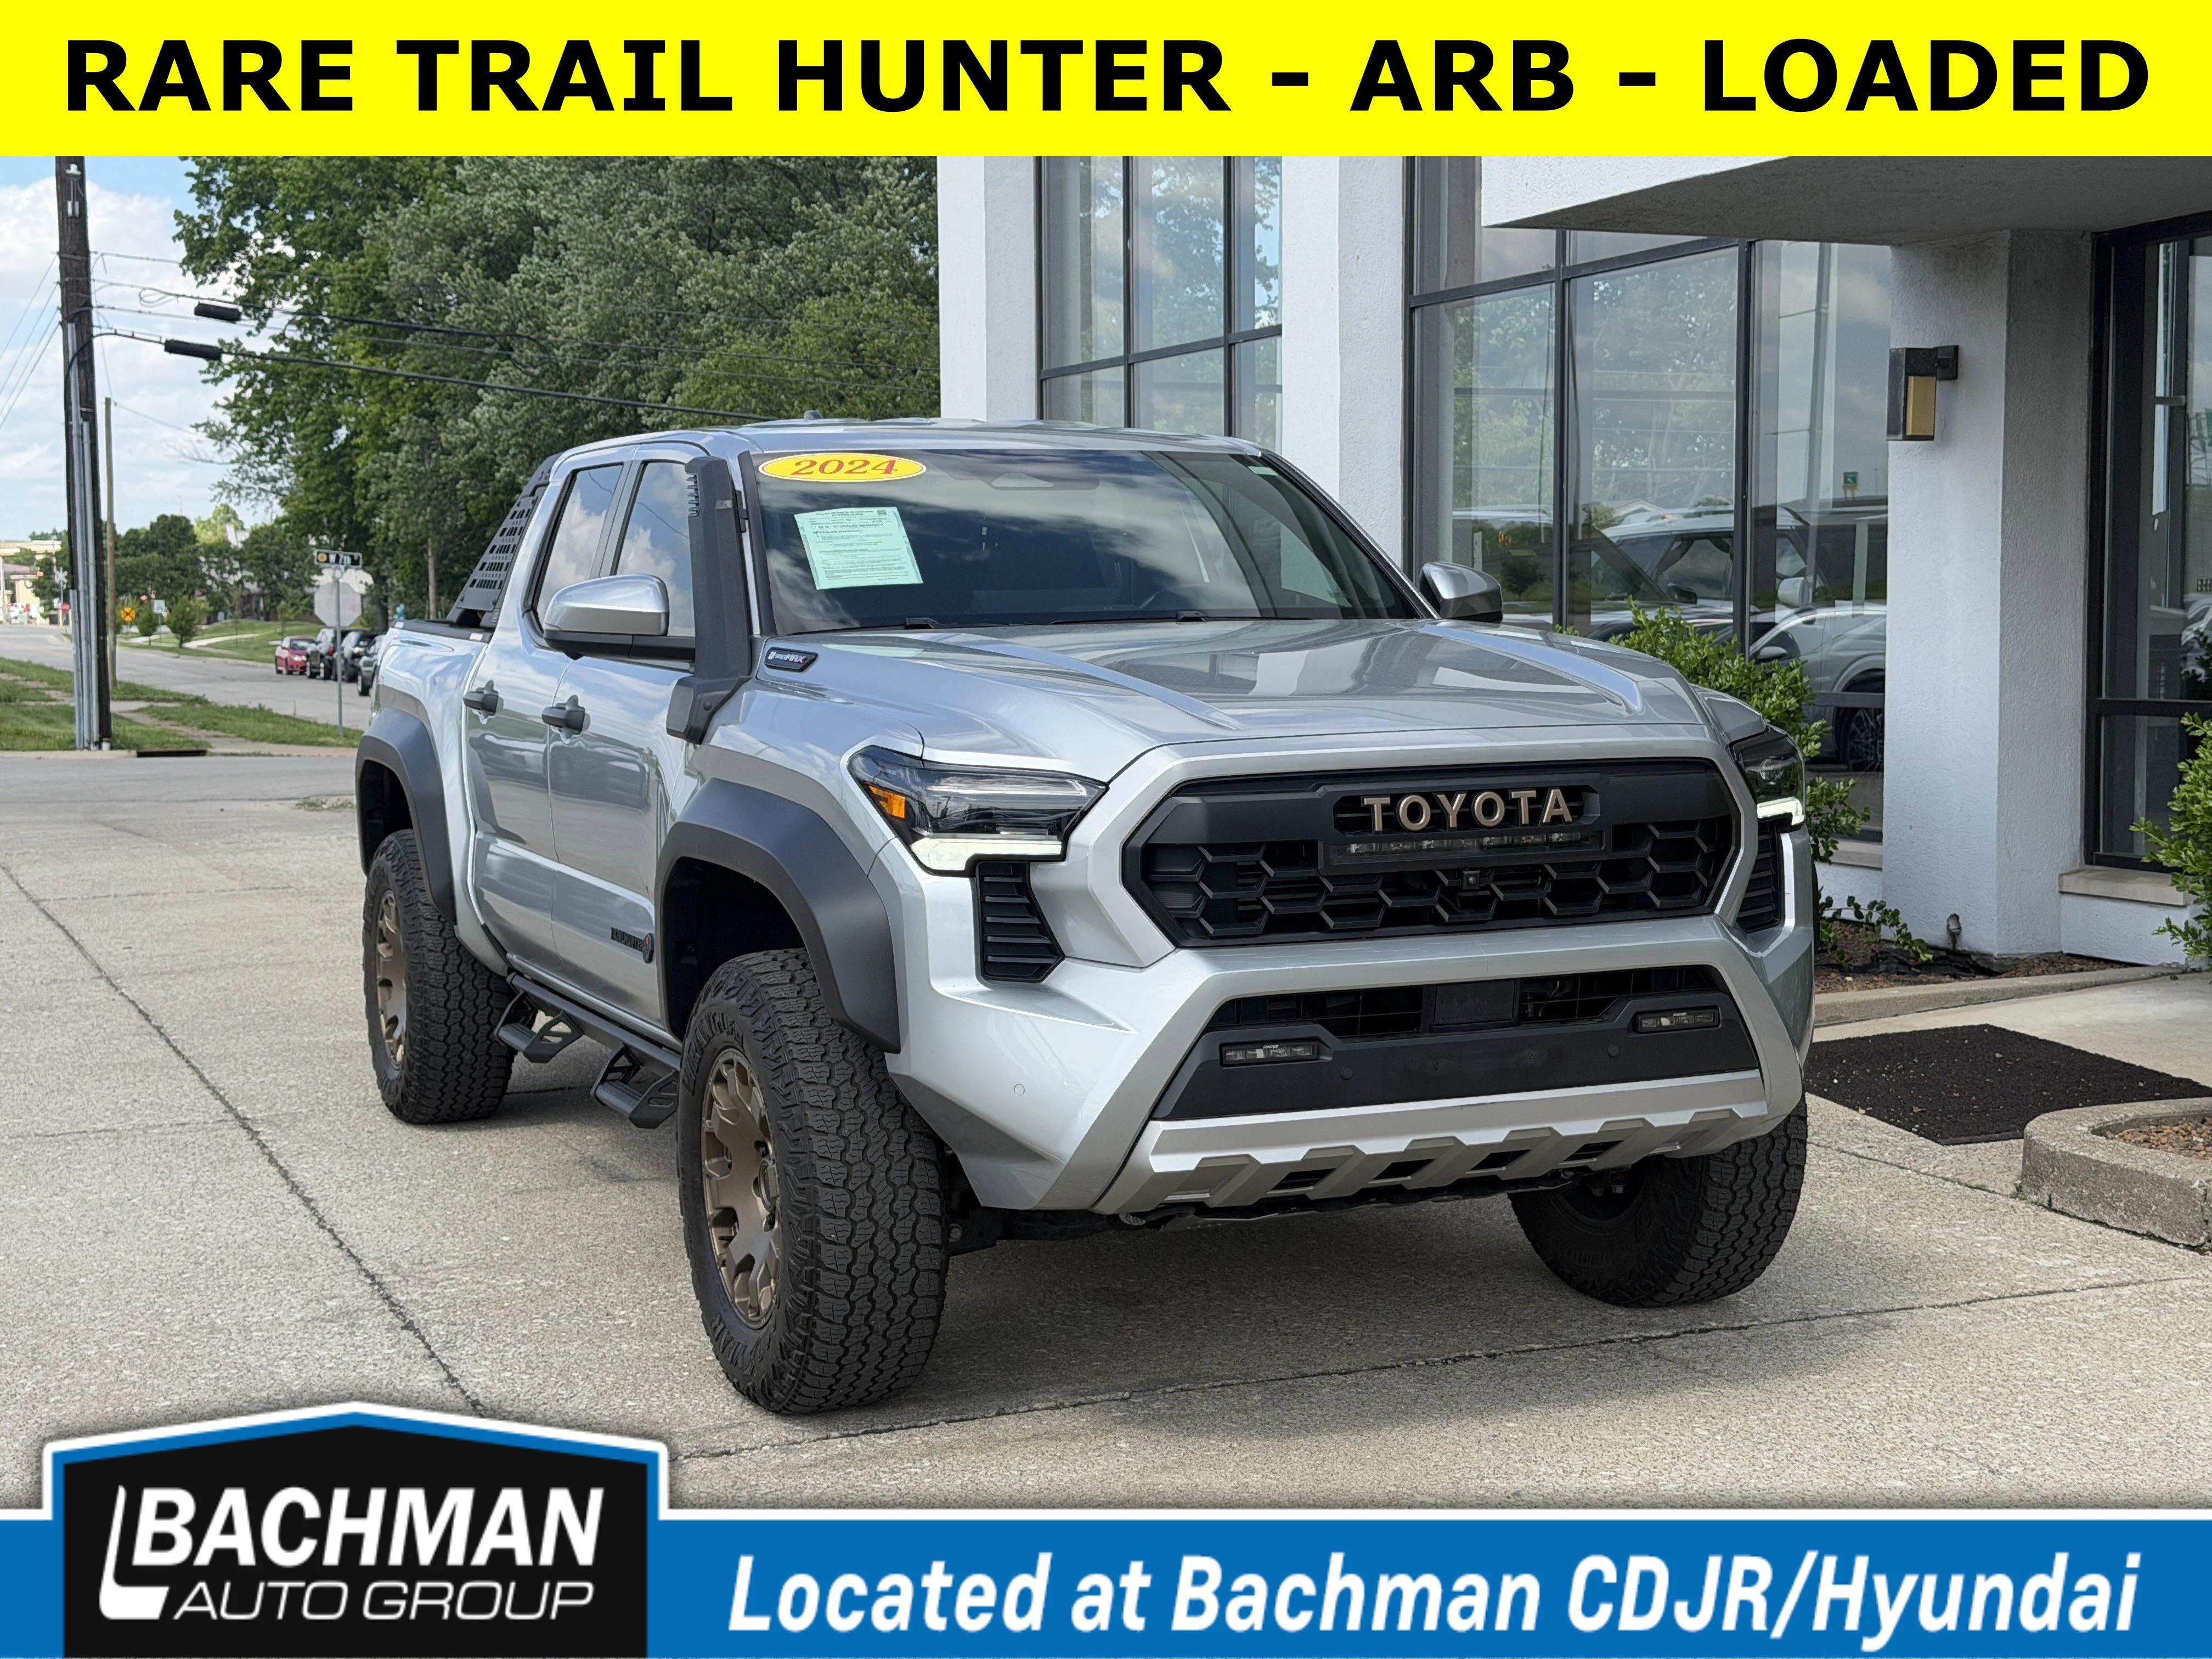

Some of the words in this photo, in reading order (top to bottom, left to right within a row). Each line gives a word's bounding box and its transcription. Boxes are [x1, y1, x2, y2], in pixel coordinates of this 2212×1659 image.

[791, 459, 898, 476] 2024
[1362, 788, 1573, 832] TOYOTA
[682, 1012, 746, 1096] WRANGLER
